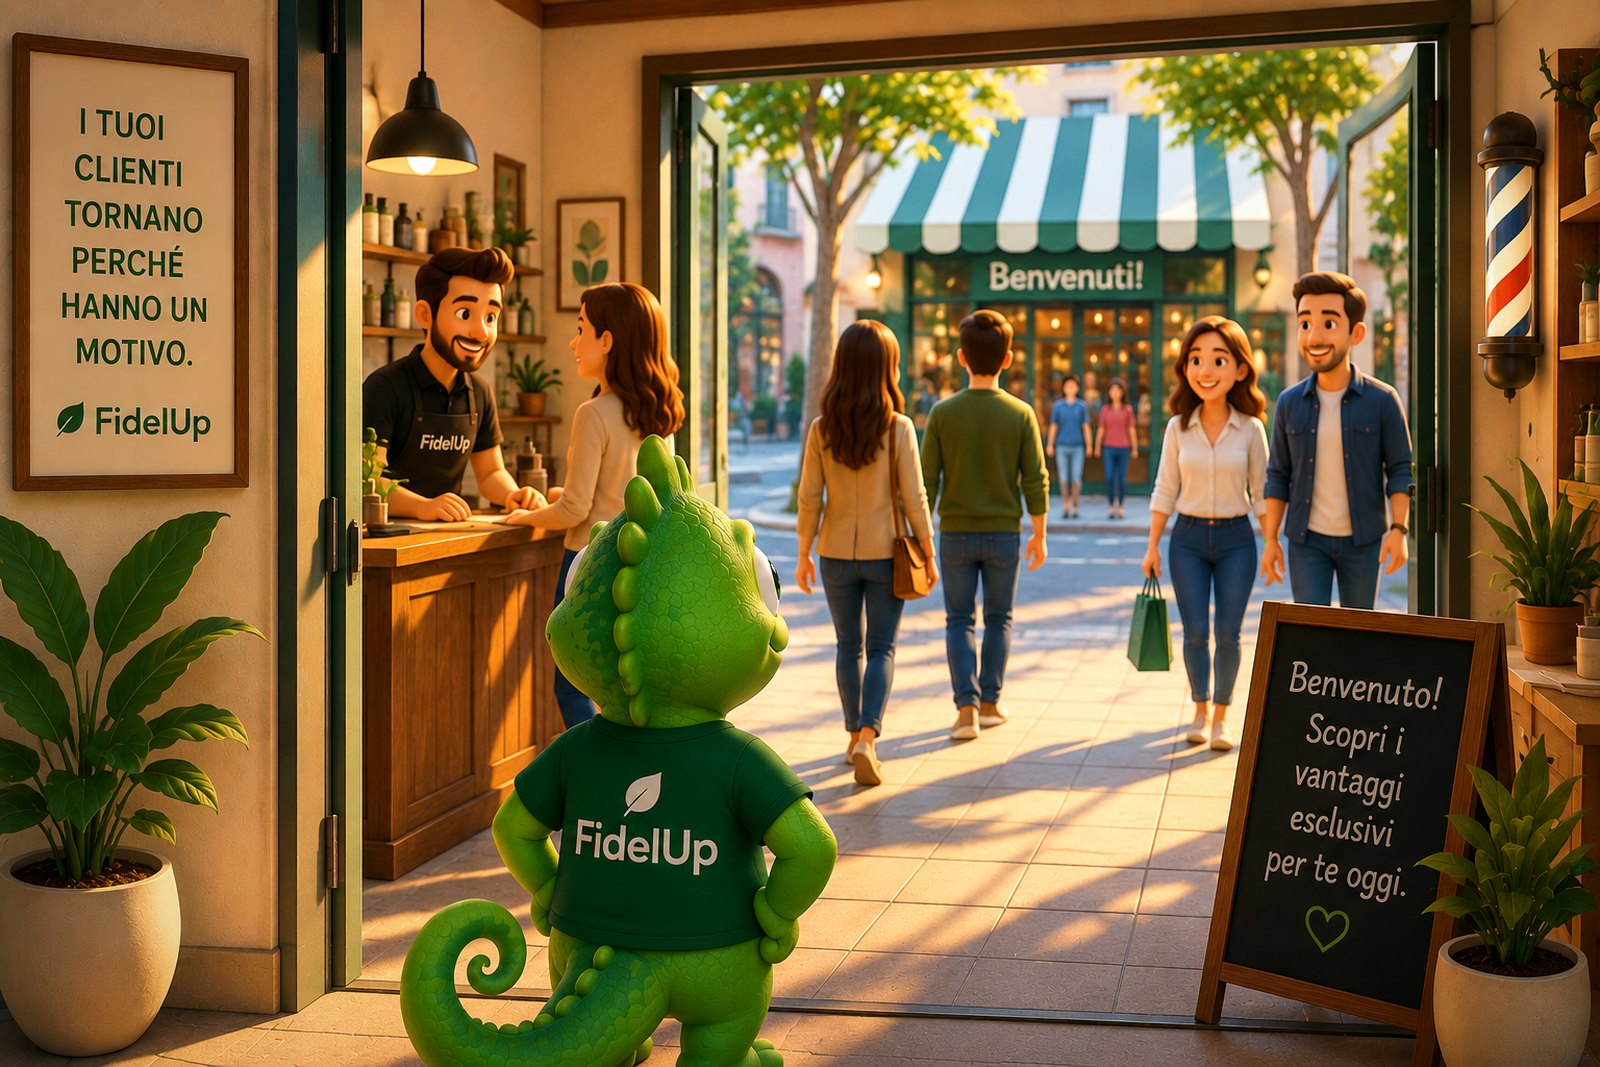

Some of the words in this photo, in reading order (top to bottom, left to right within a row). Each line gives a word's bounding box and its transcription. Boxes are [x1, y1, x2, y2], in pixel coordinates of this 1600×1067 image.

[80, 107, 86, 135] I
[95, 108, 164, 141] TUOI
[74, 153, 182, 188] CLIENTI
[64, 199, 203, 234] TORNANO
[72, 244, 184, 278] PERCHÉ
[989, 260, 1144, 291] Benvenuti!
[61, 291, 162, 322] HANNO
[171, 296, 207, 323] UN
[76, 337, 193, 367] MOTIVO.
[95, 406, 211, 443] FidelUp
[419, 434, 471, 453] FidelUp
[1289, 660, 1444, 711] Benvenuto!
[1305, 712, 1389, 759] Scopri
[1395, 727, 1405, 755] i
[1295, 764, 1404, 809] vantaggi
[1290, 805, 1394, 847] esclusivi
[575, 818, 718, 876] FidelUp
[1264, 850, 1308, 882] per
[1314, 853, 1339, 884] te
[1346, 867, 1406, 904] oggi.
